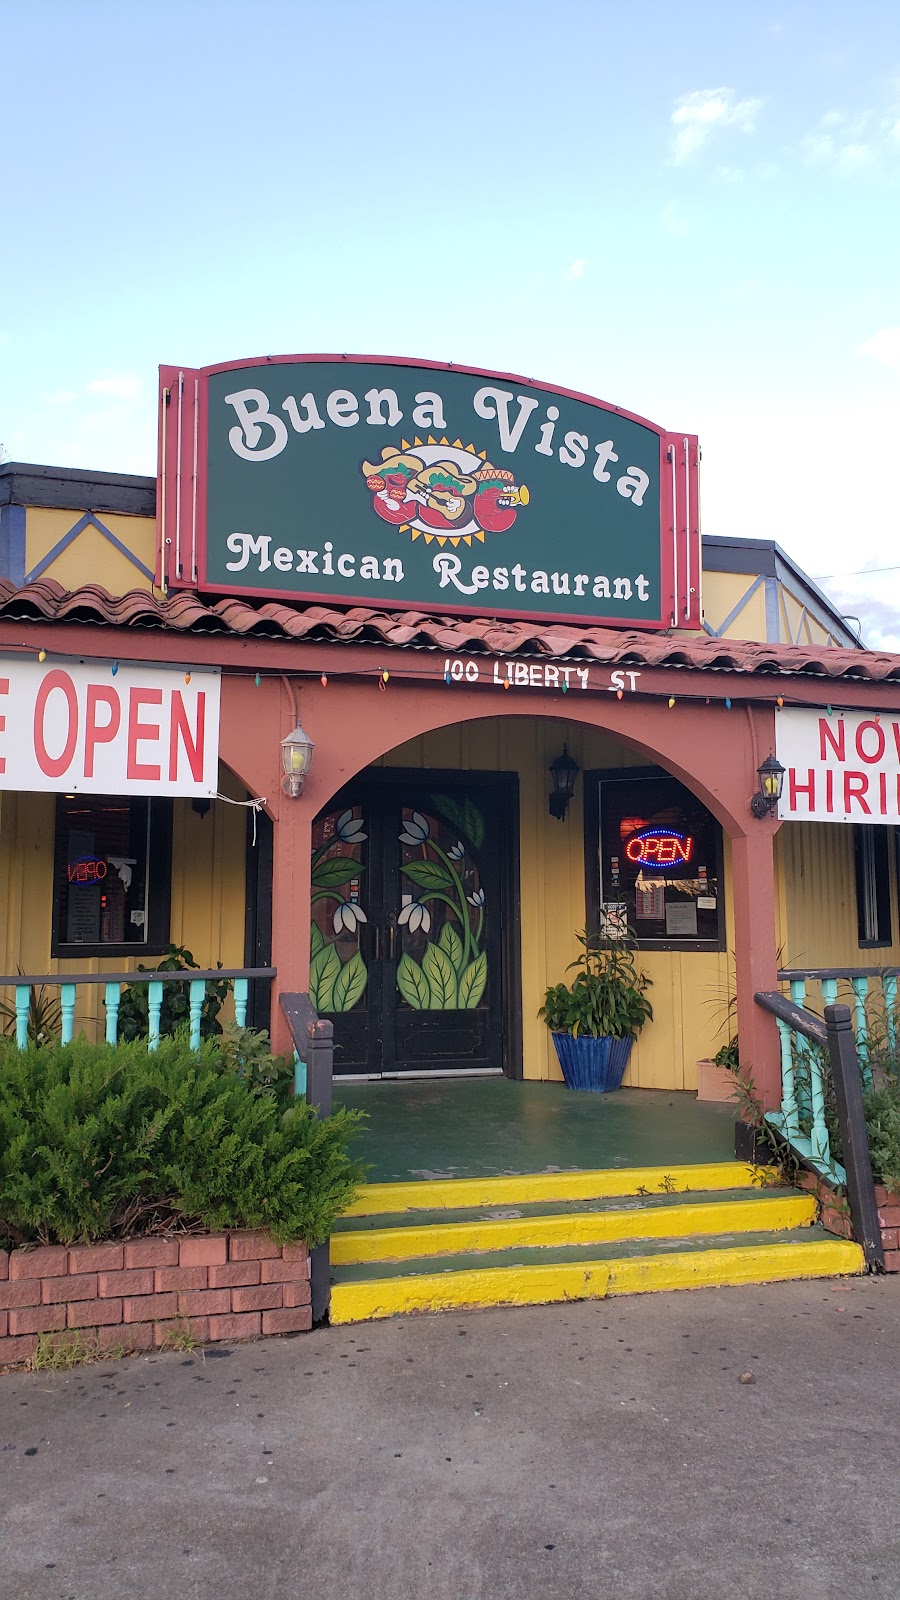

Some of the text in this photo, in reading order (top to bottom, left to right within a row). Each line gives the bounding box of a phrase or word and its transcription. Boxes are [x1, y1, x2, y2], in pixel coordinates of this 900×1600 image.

[224, 386, 649, 507] Buena Vista
[226, 533, 649, 602] Mexican Restaurant
[443, 658, 641, 692] 100 LIBERTY ST
[33, 669, 206, 783] OPEN
[788, 767, 900, 816] HIRI
[626, 837, 692, 861] OPEN
